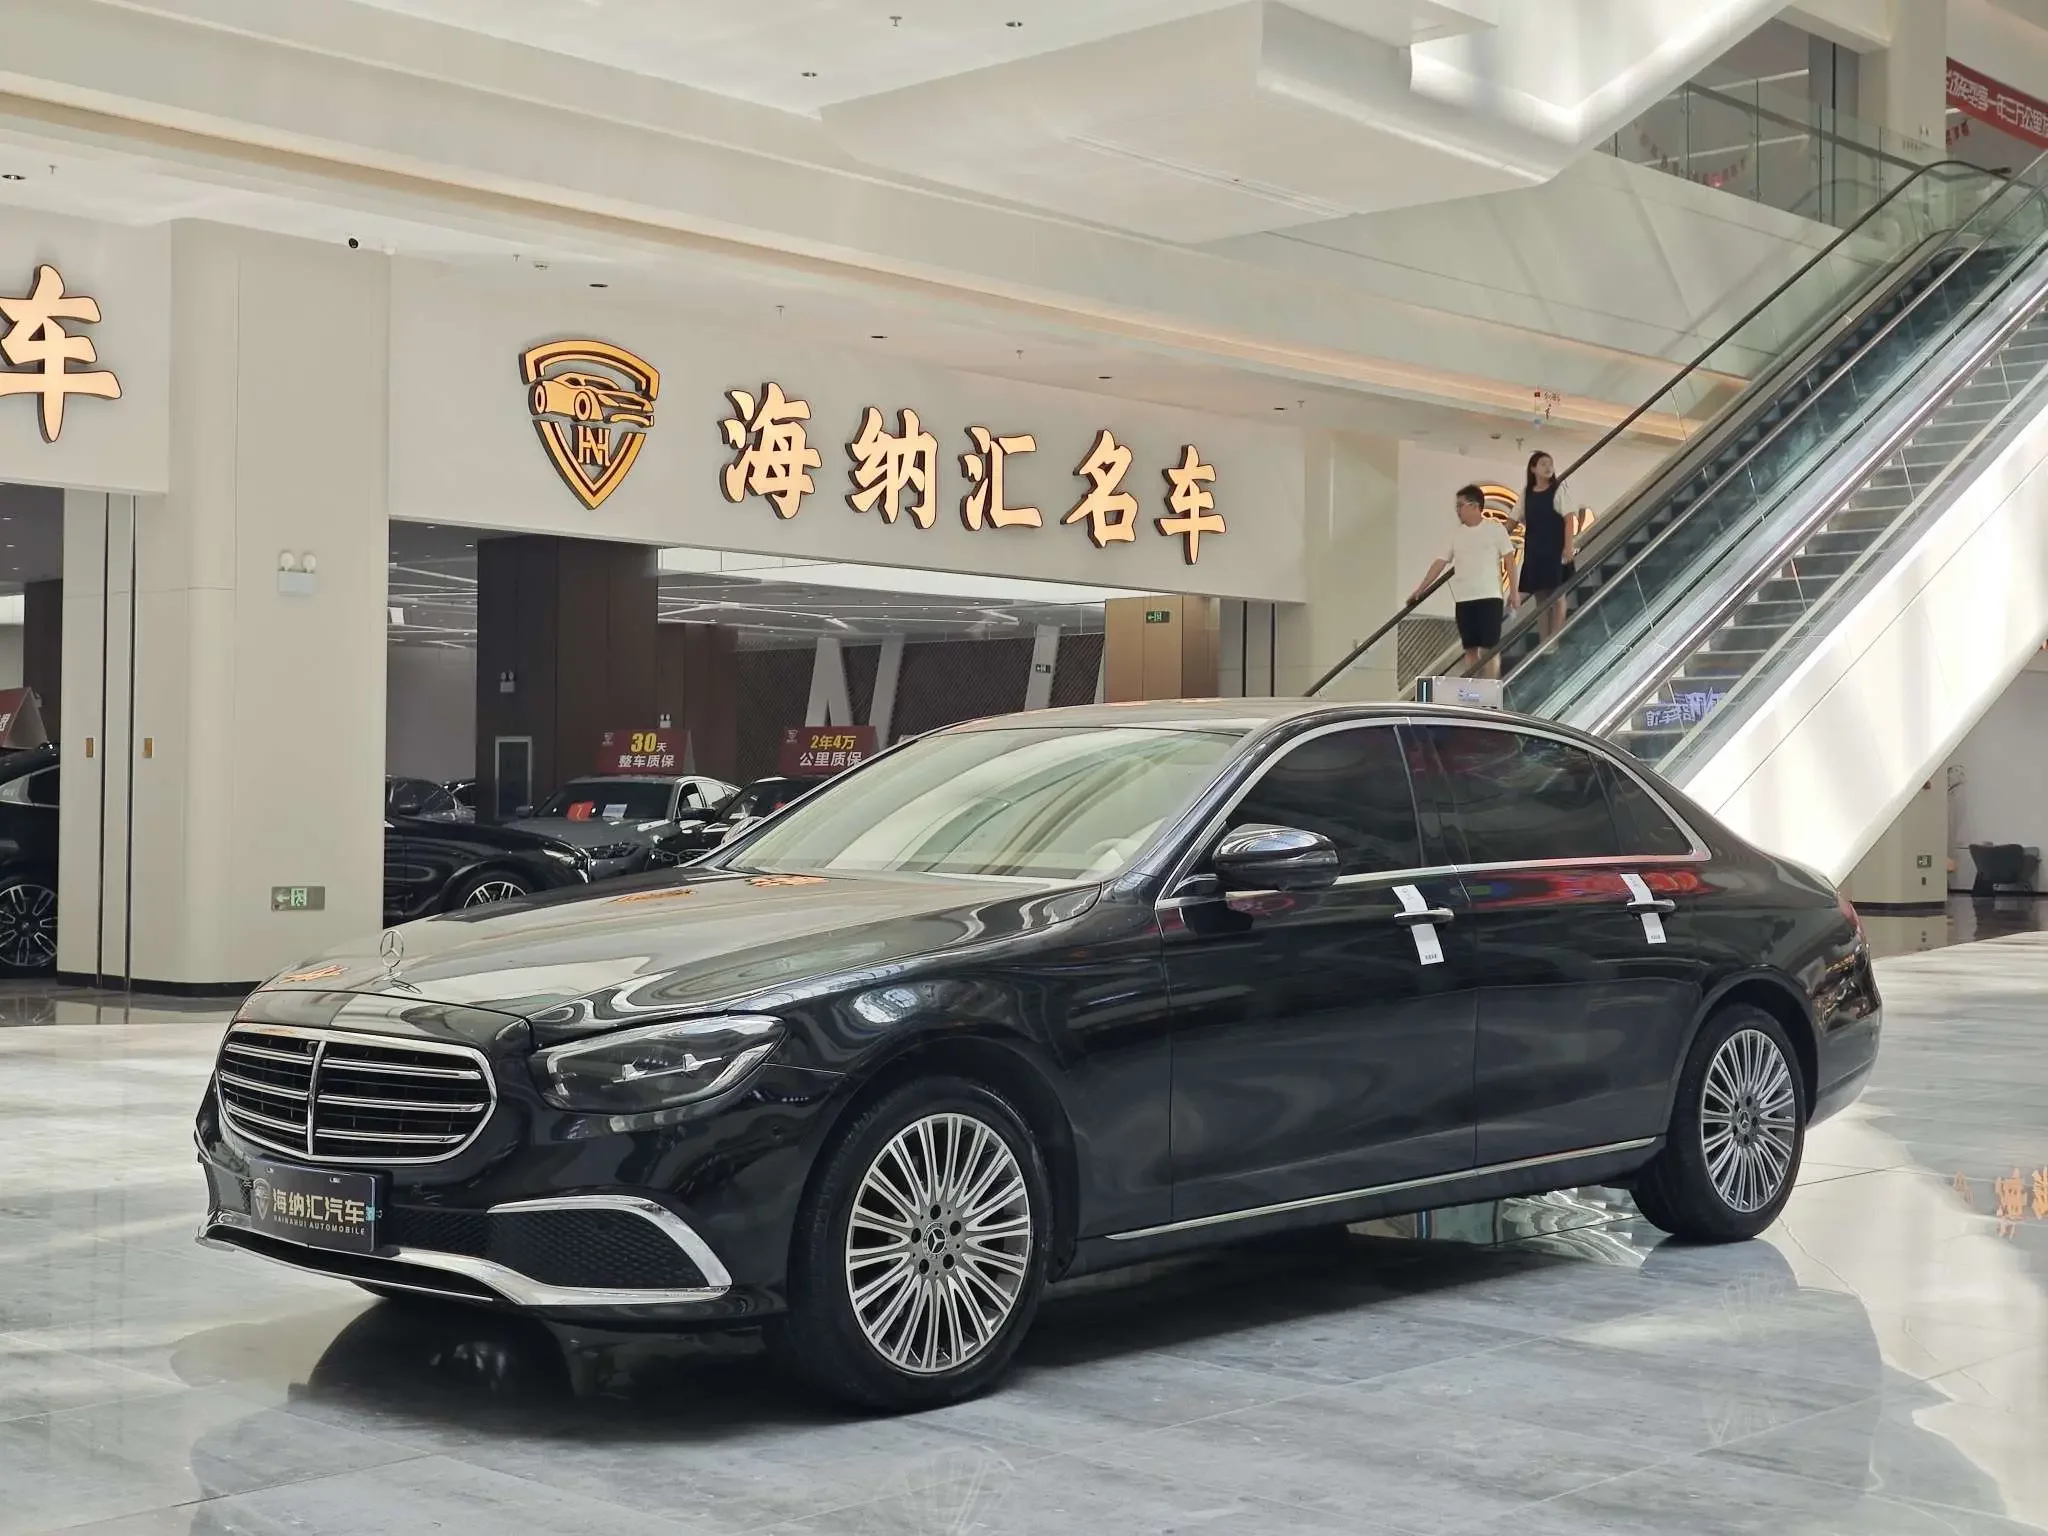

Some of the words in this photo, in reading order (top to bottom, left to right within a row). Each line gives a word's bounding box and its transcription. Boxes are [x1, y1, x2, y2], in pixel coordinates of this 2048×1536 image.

[0, 264, 122, 443] 车
[718, 381, 1228, 565] 海纳汇名车
[630, 732, 668, 753] 30天
[810, 735, 857, 750] 2年4万
[618, 754, 675, 768] 整车质保
[799, 751, 863, 767] 公里质保
[272, 1188, 365, 1224] 海纳汇汽车
[309, 1222, 366, 1236] AUTOMOBILE
